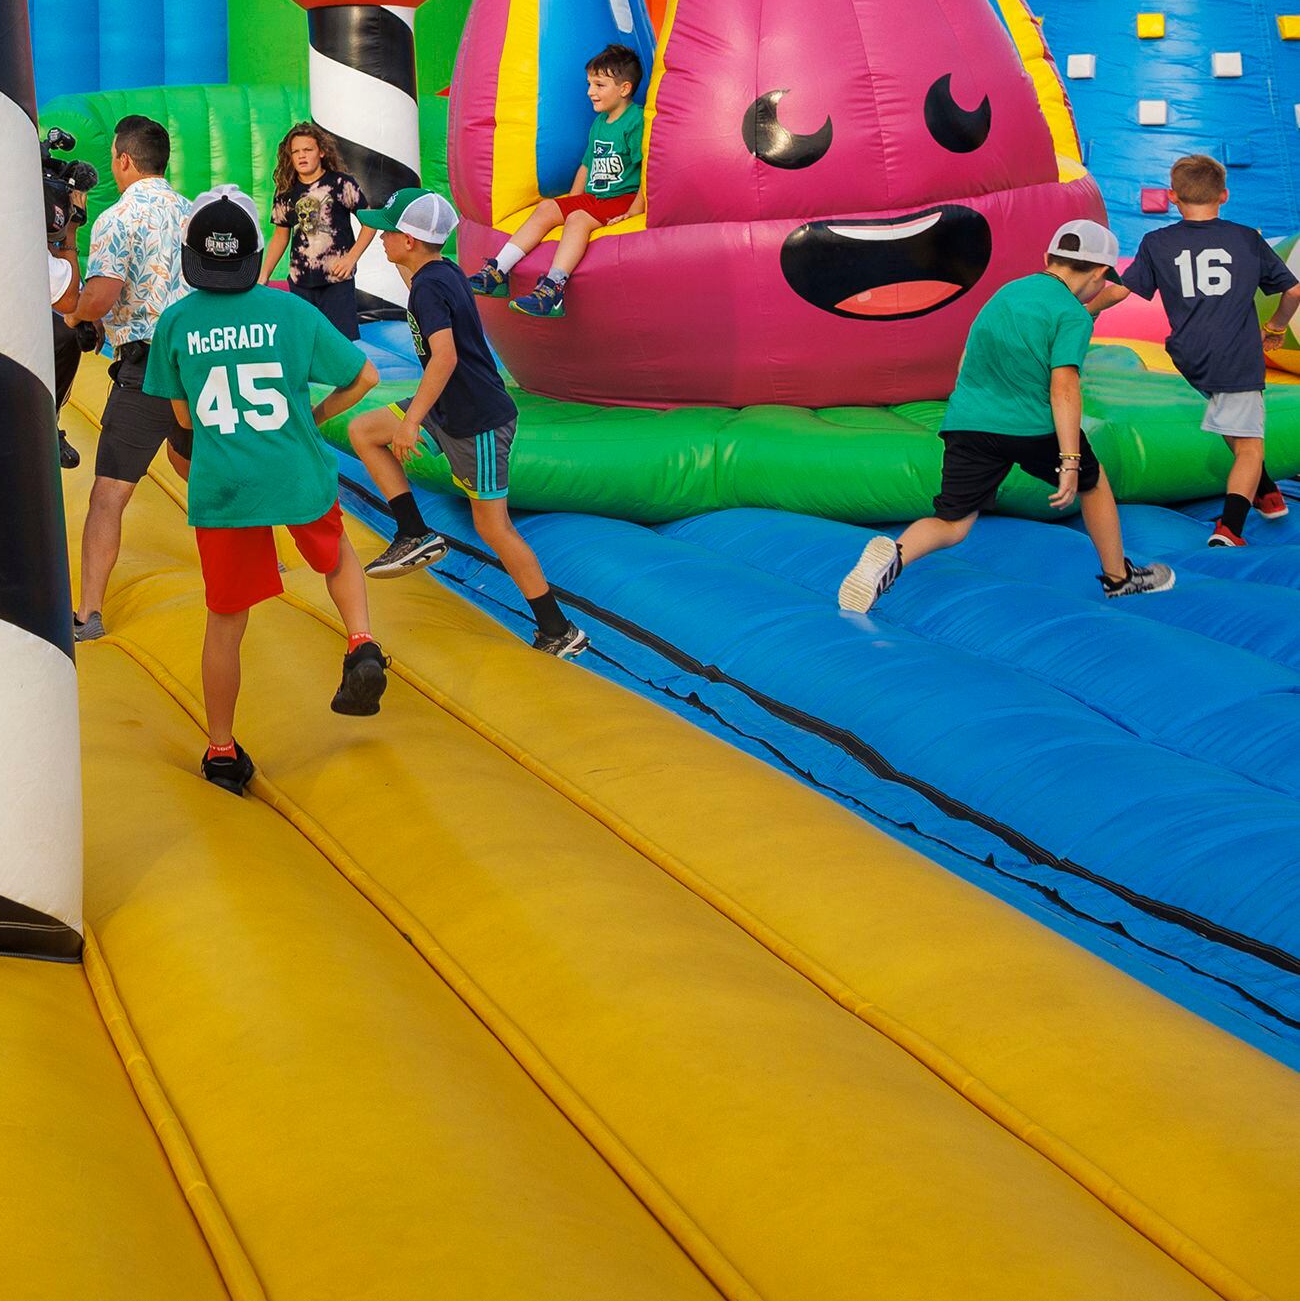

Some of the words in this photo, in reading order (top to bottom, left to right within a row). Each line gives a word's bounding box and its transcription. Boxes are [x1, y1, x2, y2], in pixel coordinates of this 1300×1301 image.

[1174, 248, 1233, 298] 16
[187, 323, 278, 356] McGRADY
[196, 362, 290, 435] 45
